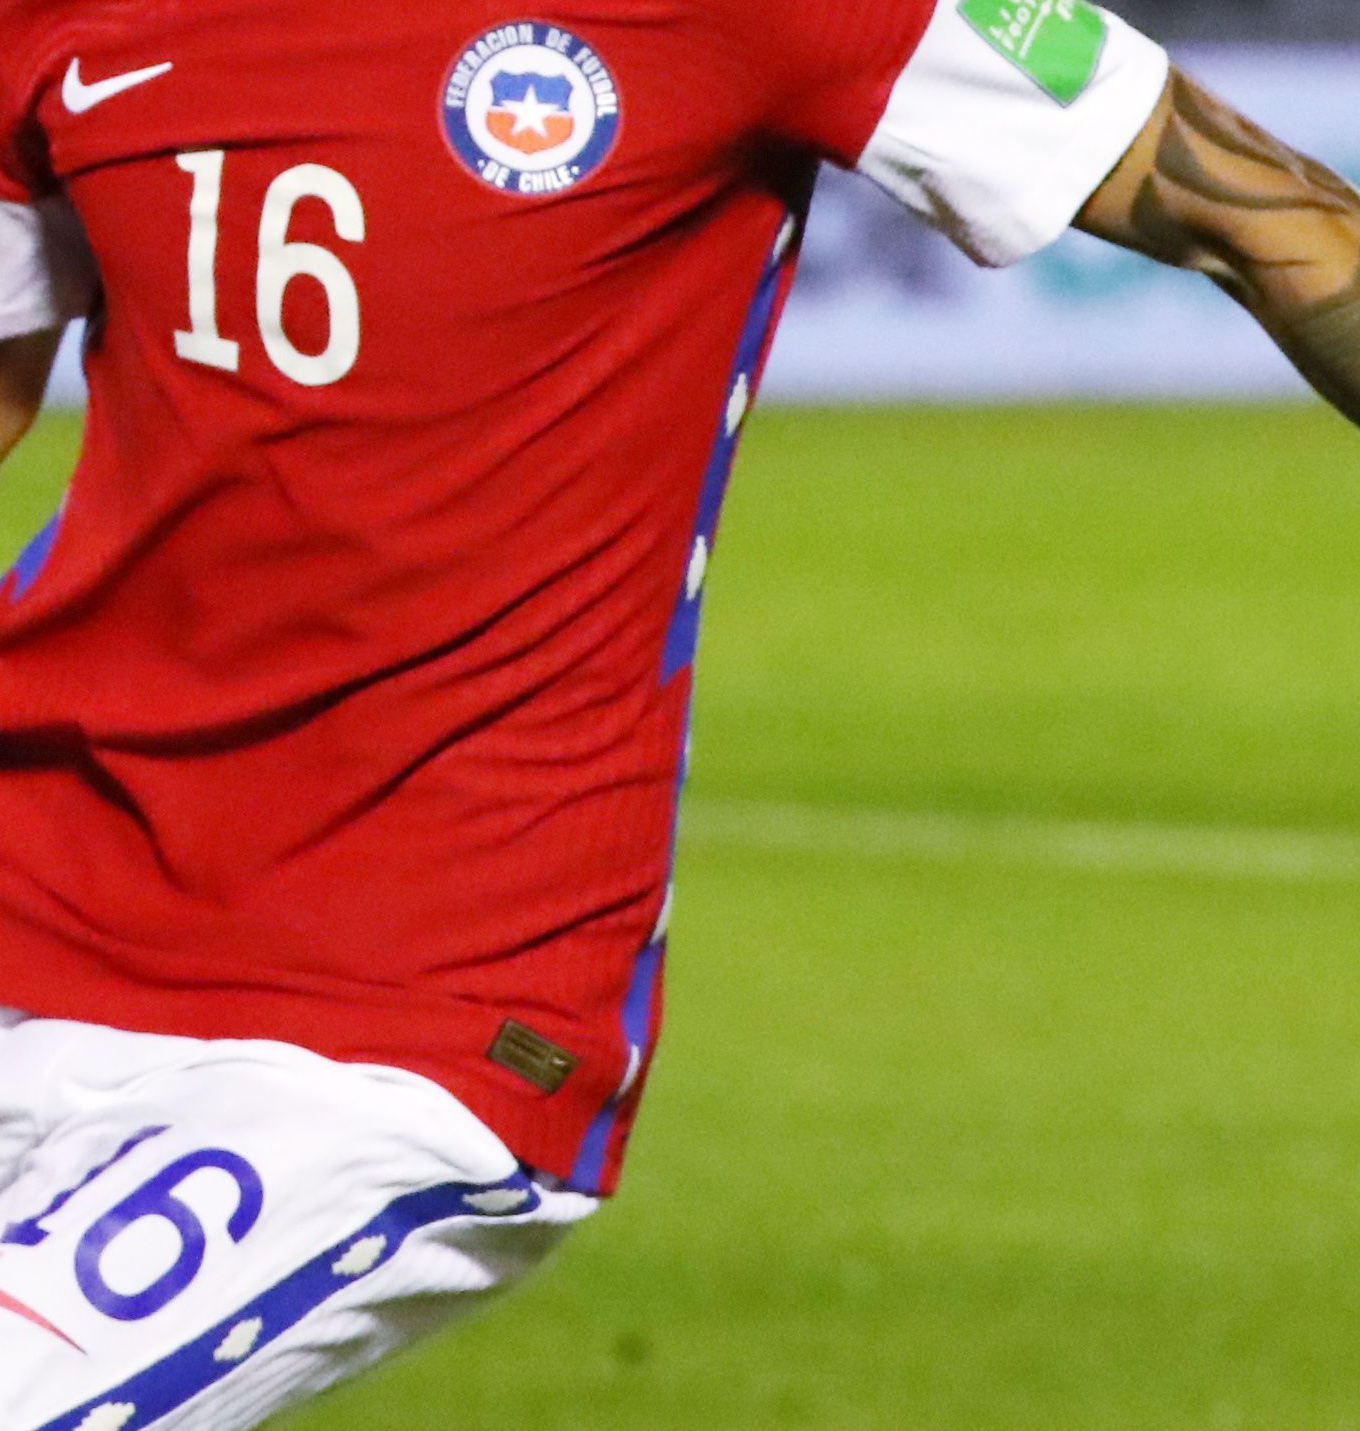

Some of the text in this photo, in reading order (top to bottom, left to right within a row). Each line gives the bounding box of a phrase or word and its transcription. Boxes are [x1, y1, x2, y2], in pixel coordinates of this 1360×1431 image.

[445, 23, 618, 118] FEDERACION DE FUTBOL
[482, 160, 573, 193] DE CHILE
[173, 149, 366, 387] 16
